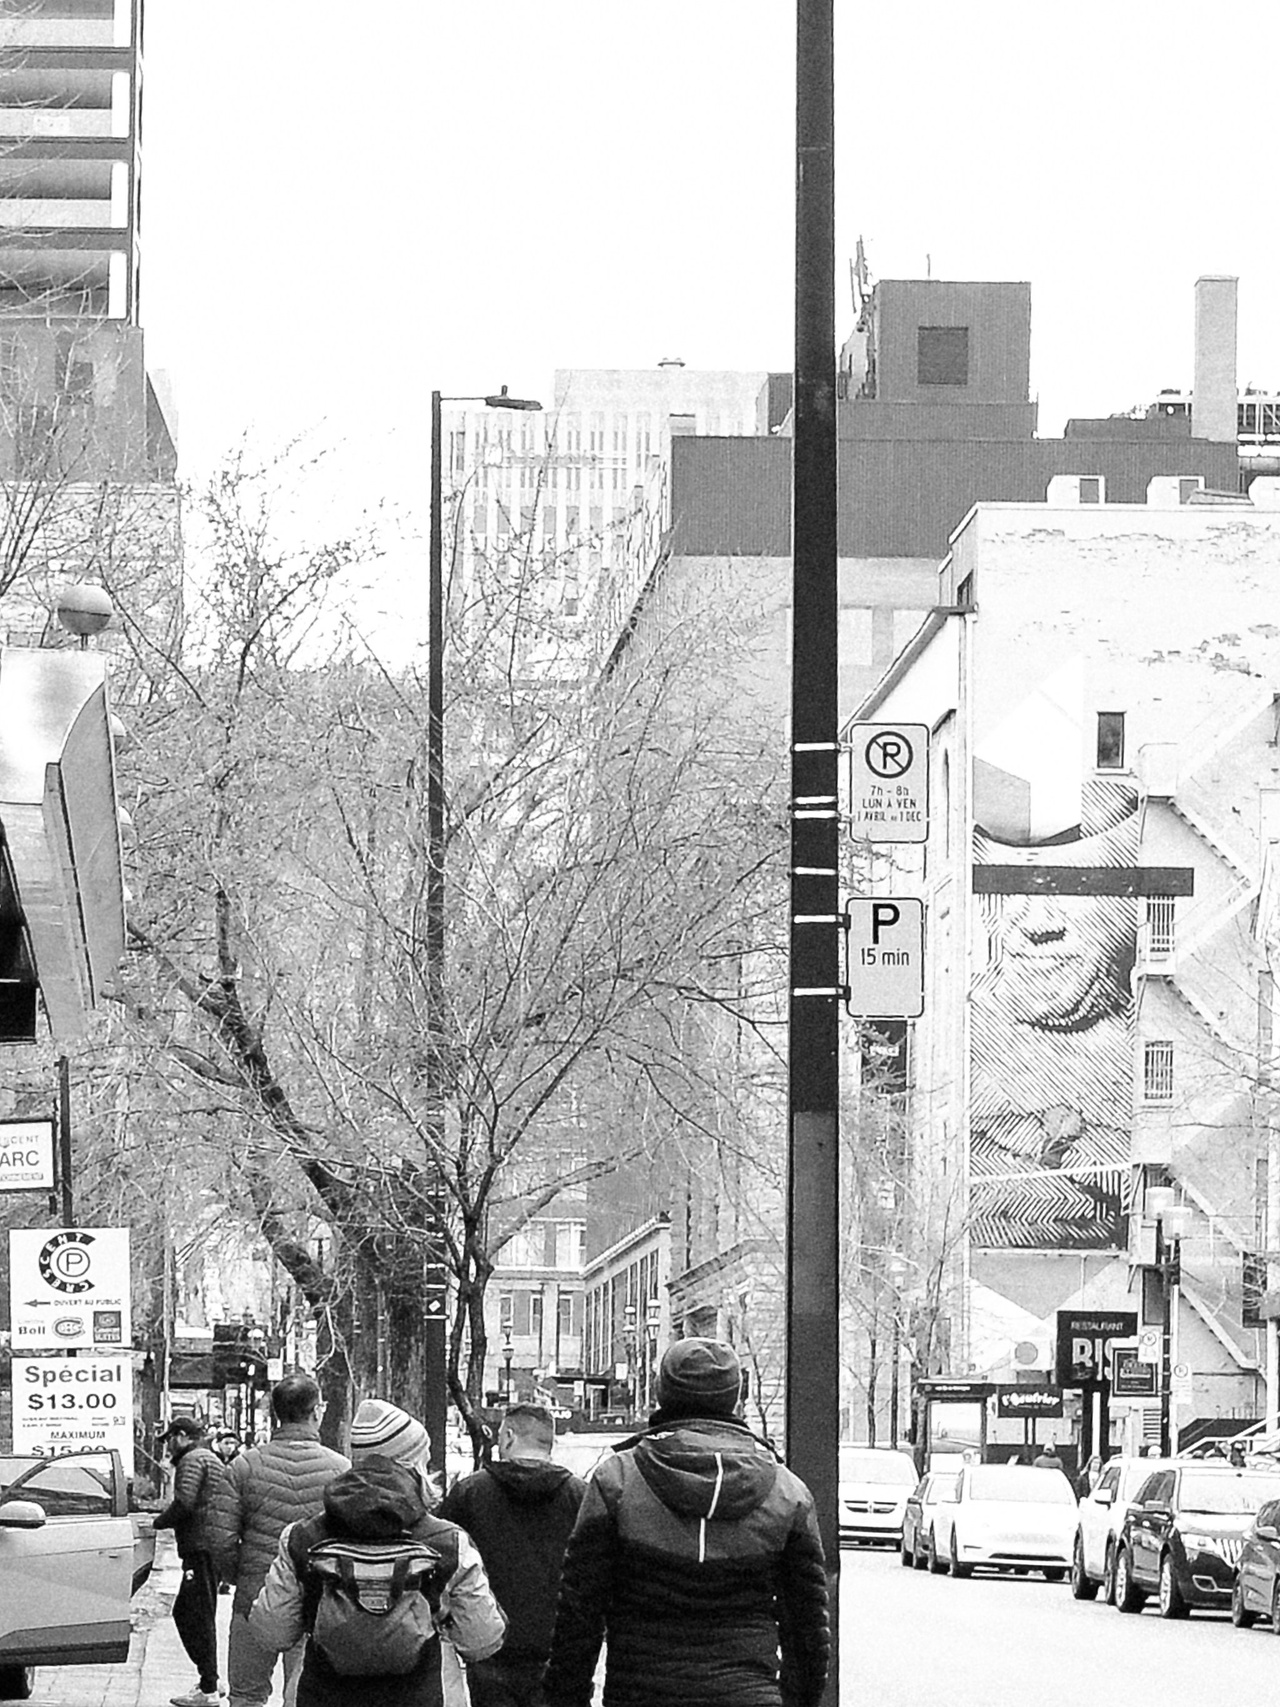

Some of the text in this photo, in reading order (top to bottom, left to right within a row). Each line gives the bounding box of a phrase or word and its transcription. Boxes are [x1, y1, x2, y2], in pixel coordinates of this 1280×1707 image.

[871, 785, 883, 796] 7h
[896, 785, 909, 796] 8h
[862, 798, 882, 809] LUN
[896, 798, 916, 809] VEN
[872, 903, 900, 944] P
[861, 947, 909, 965] 15 min
[24, 1364, 122, 1388] Spécial
[28, 1393, 117, 1411] $13.00
[50, 1431, 106, 1440] MAXIMUM
